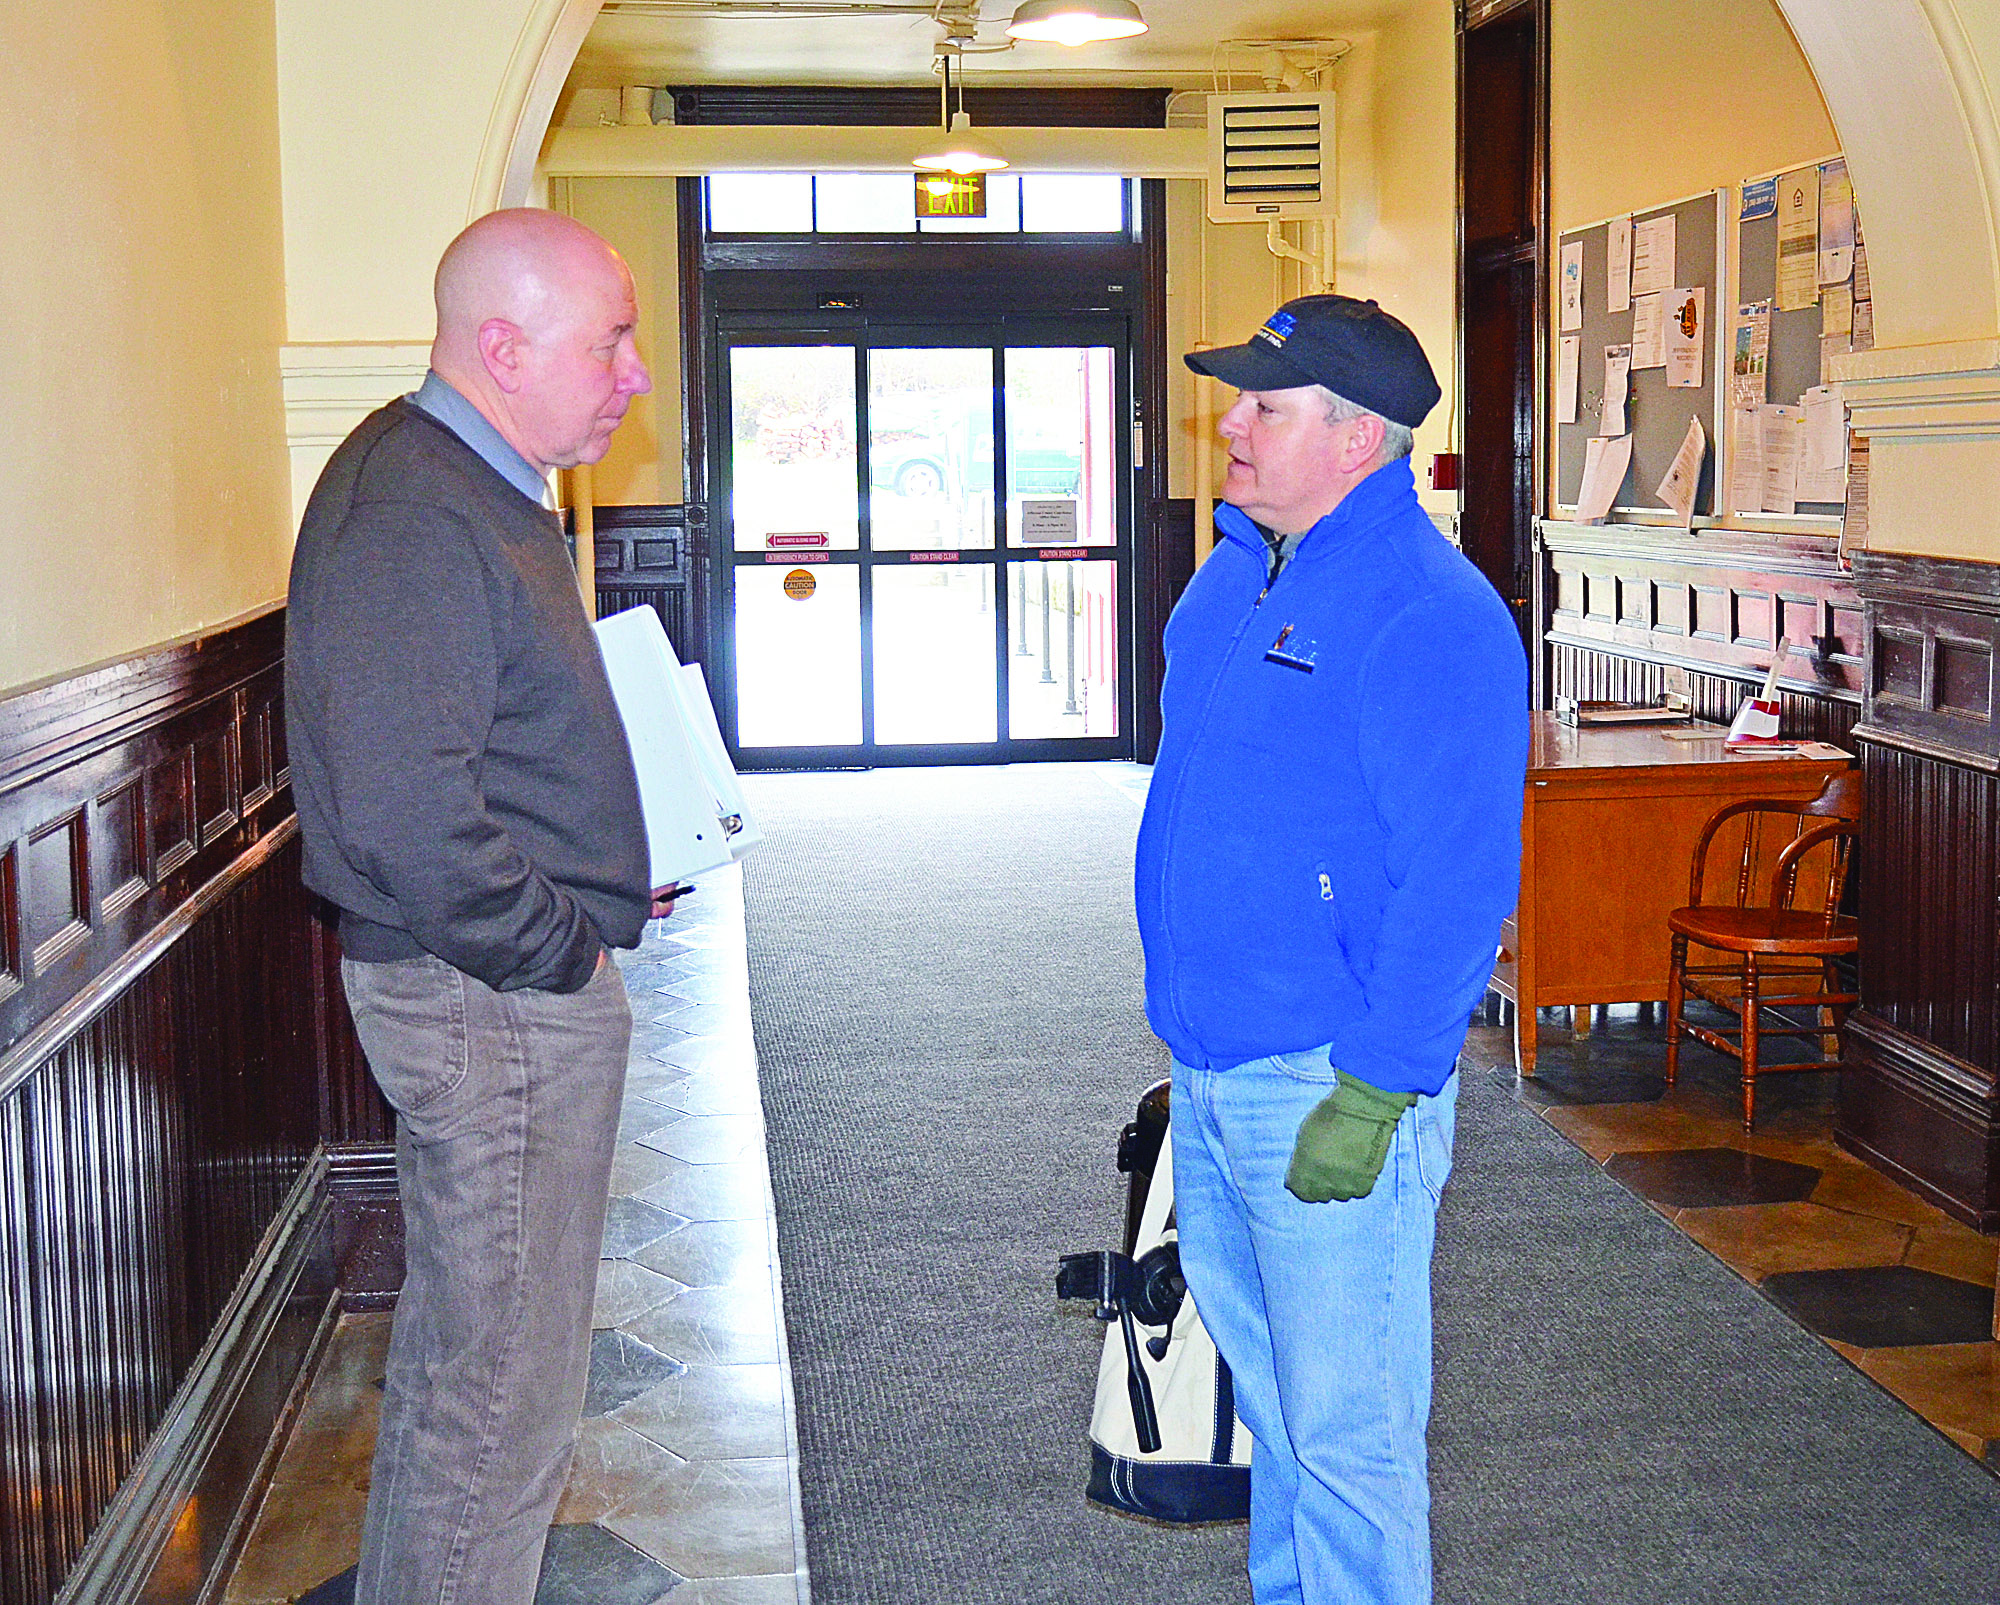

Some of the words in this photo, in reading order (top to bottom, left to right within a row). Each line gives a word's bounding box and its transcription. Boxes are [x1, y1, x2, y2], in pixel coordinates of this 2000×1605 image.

[928, 177, 979, 214] EXIT
[911, 553, 929, 561] CAUTION
[1040, 550, 1058, 558] CAUTION
[1071, 549, 1086, 557] CLEAR
